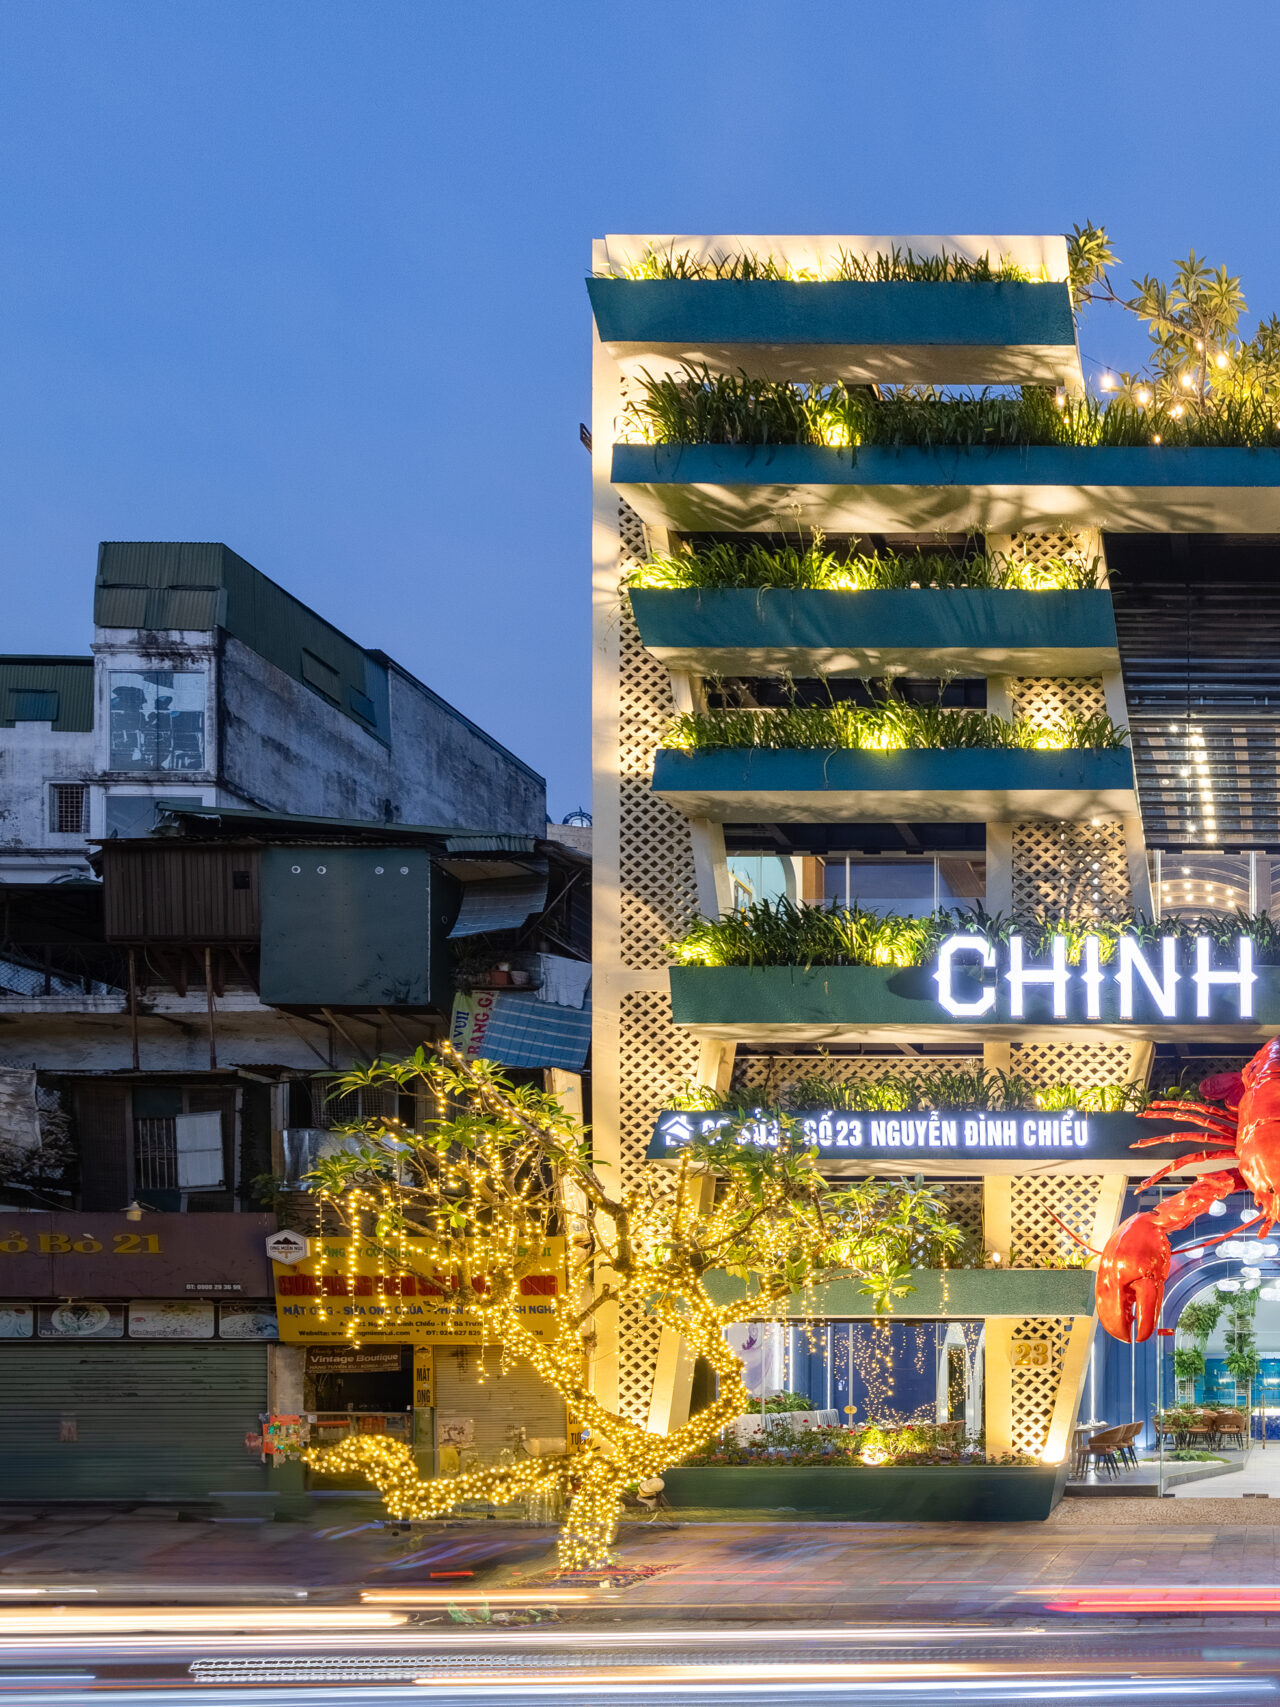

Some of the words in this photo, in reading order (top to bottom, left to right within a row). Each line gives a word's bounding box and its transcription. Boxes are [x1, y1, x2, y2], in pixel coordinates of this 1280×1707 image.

[933, 936, 1258, 1018] CHINH
[803, 1111, 833, 1146] SỐ
[836, 1120, 863, 1145] 23
[871, 1111, 956, 1146] NGUYỄN
[964, 1114, 1016, 1146] ĐÌNH
[1023, 1110, 1088, 1146] CHIỂU
[37, 1233, 103, 1254] Bò
[112, 1234, 164, 1254] 21
[309, 1306, 333, 1315] OG
[311, 1355, 355, 1364] Vintage
[356, 1354, 399, 1363] Boutique
[1015, 1342, 1049, 1366] 23
